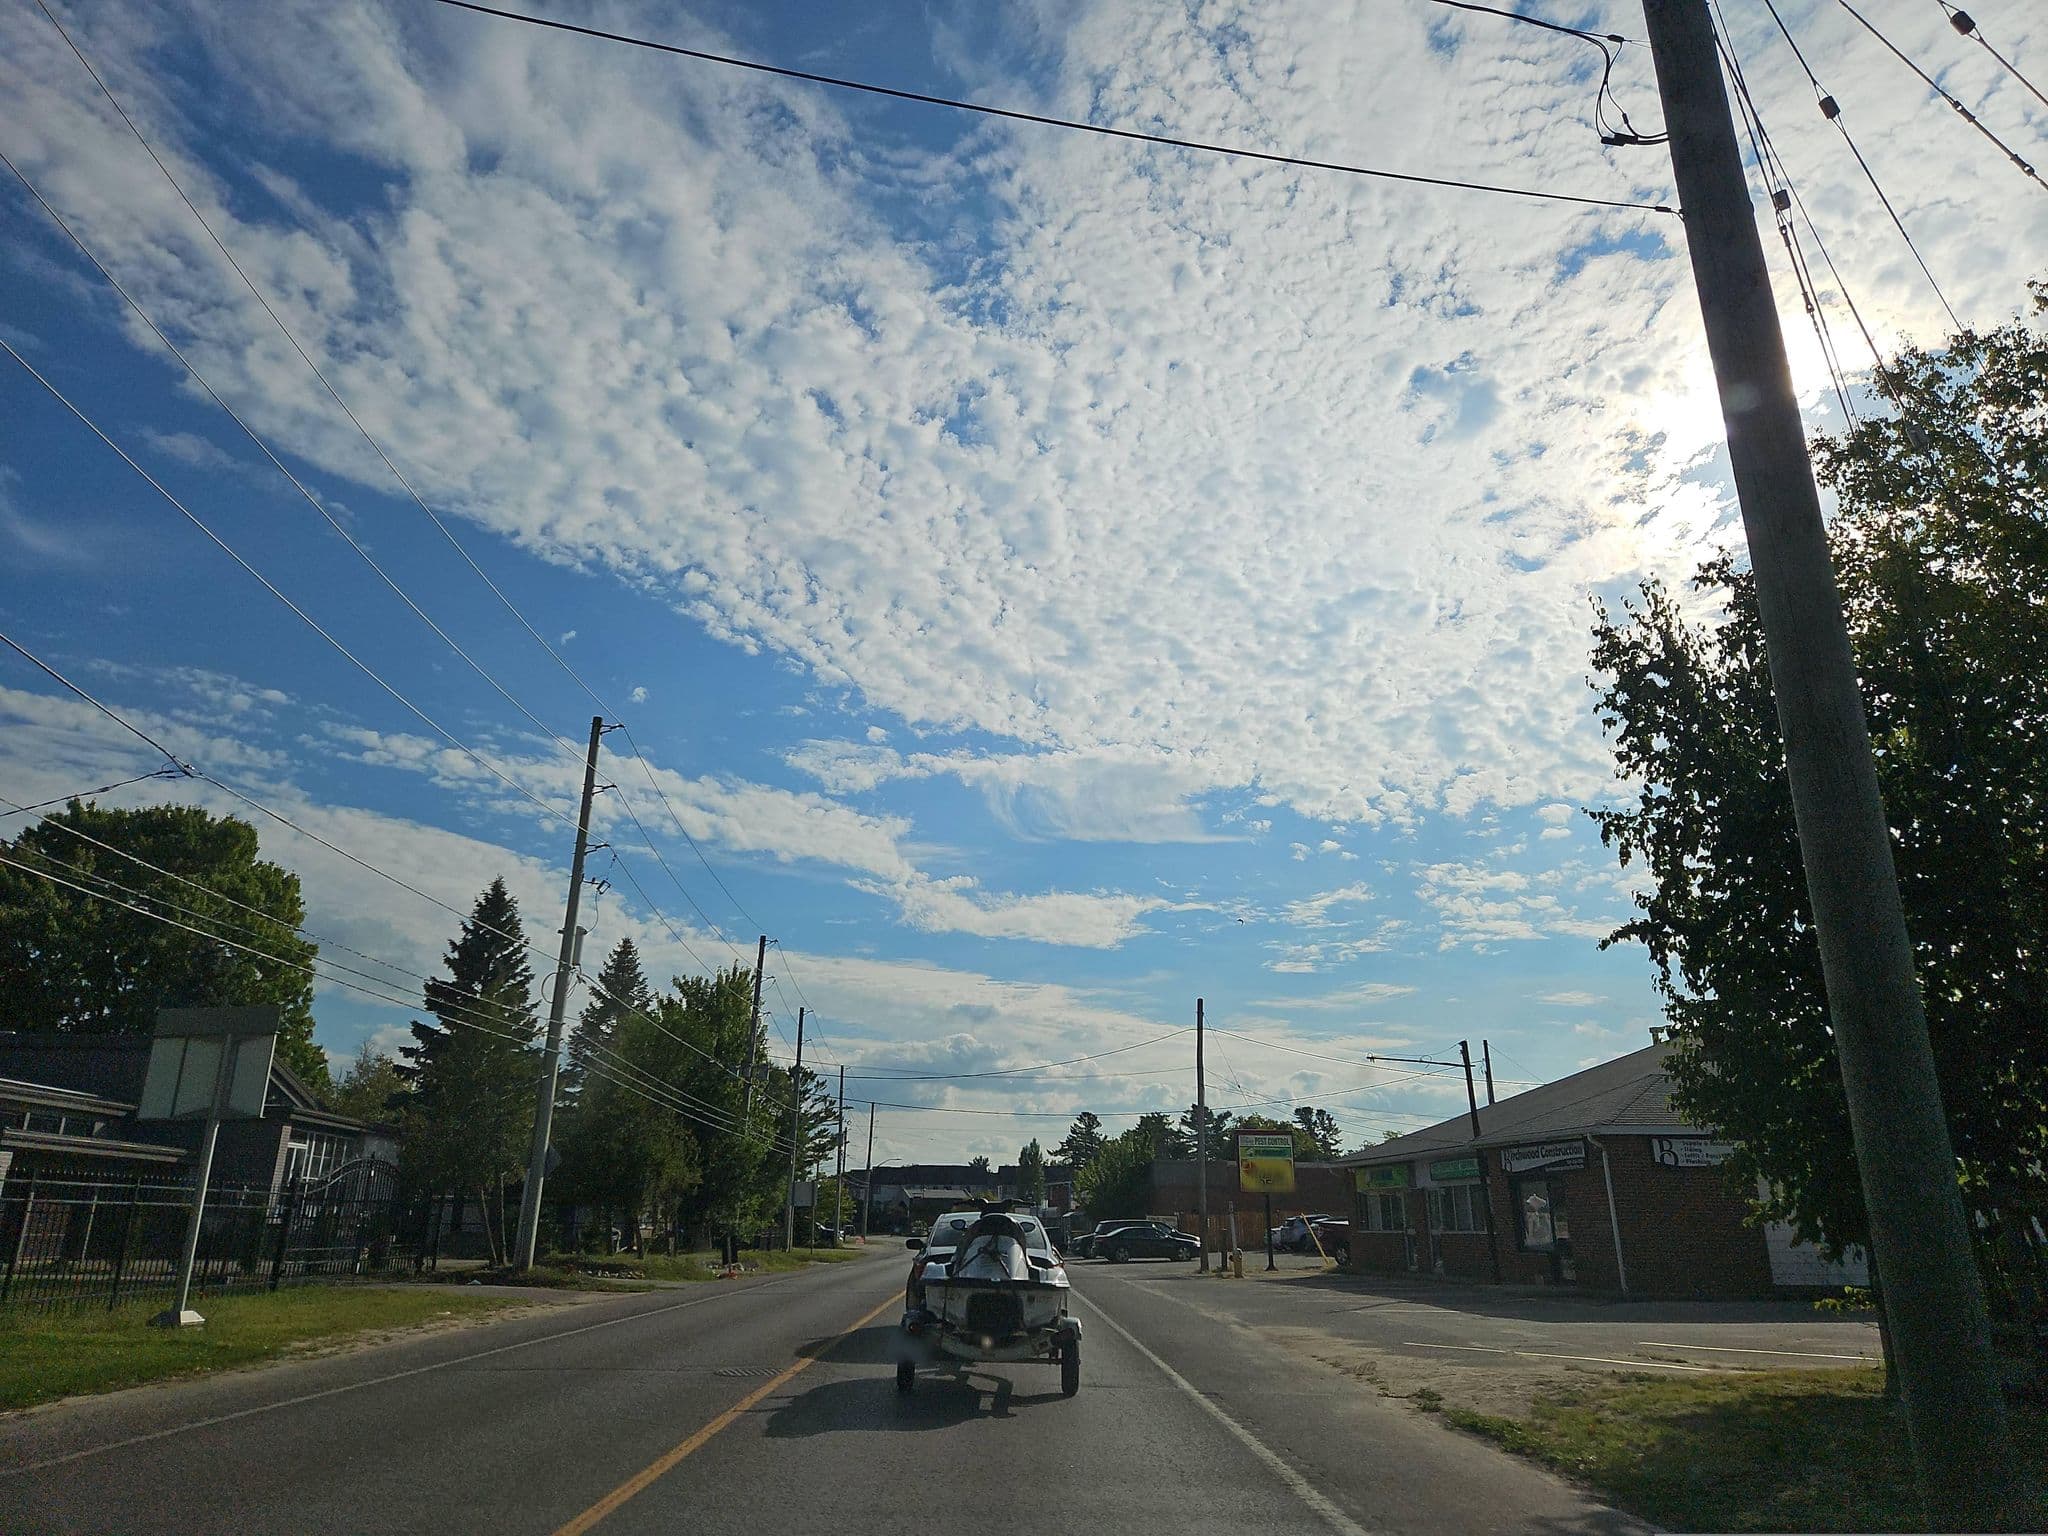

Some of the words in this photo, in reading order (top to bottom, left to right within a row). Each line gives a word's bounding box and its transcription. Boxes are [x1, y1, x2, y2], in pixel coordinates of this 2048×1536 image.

[1255, 1137, 1267, 1145] PEST
[1268, 1137, 1289, 1146] CONTROL
[1540, 1143, 1583, 1158] Construction
